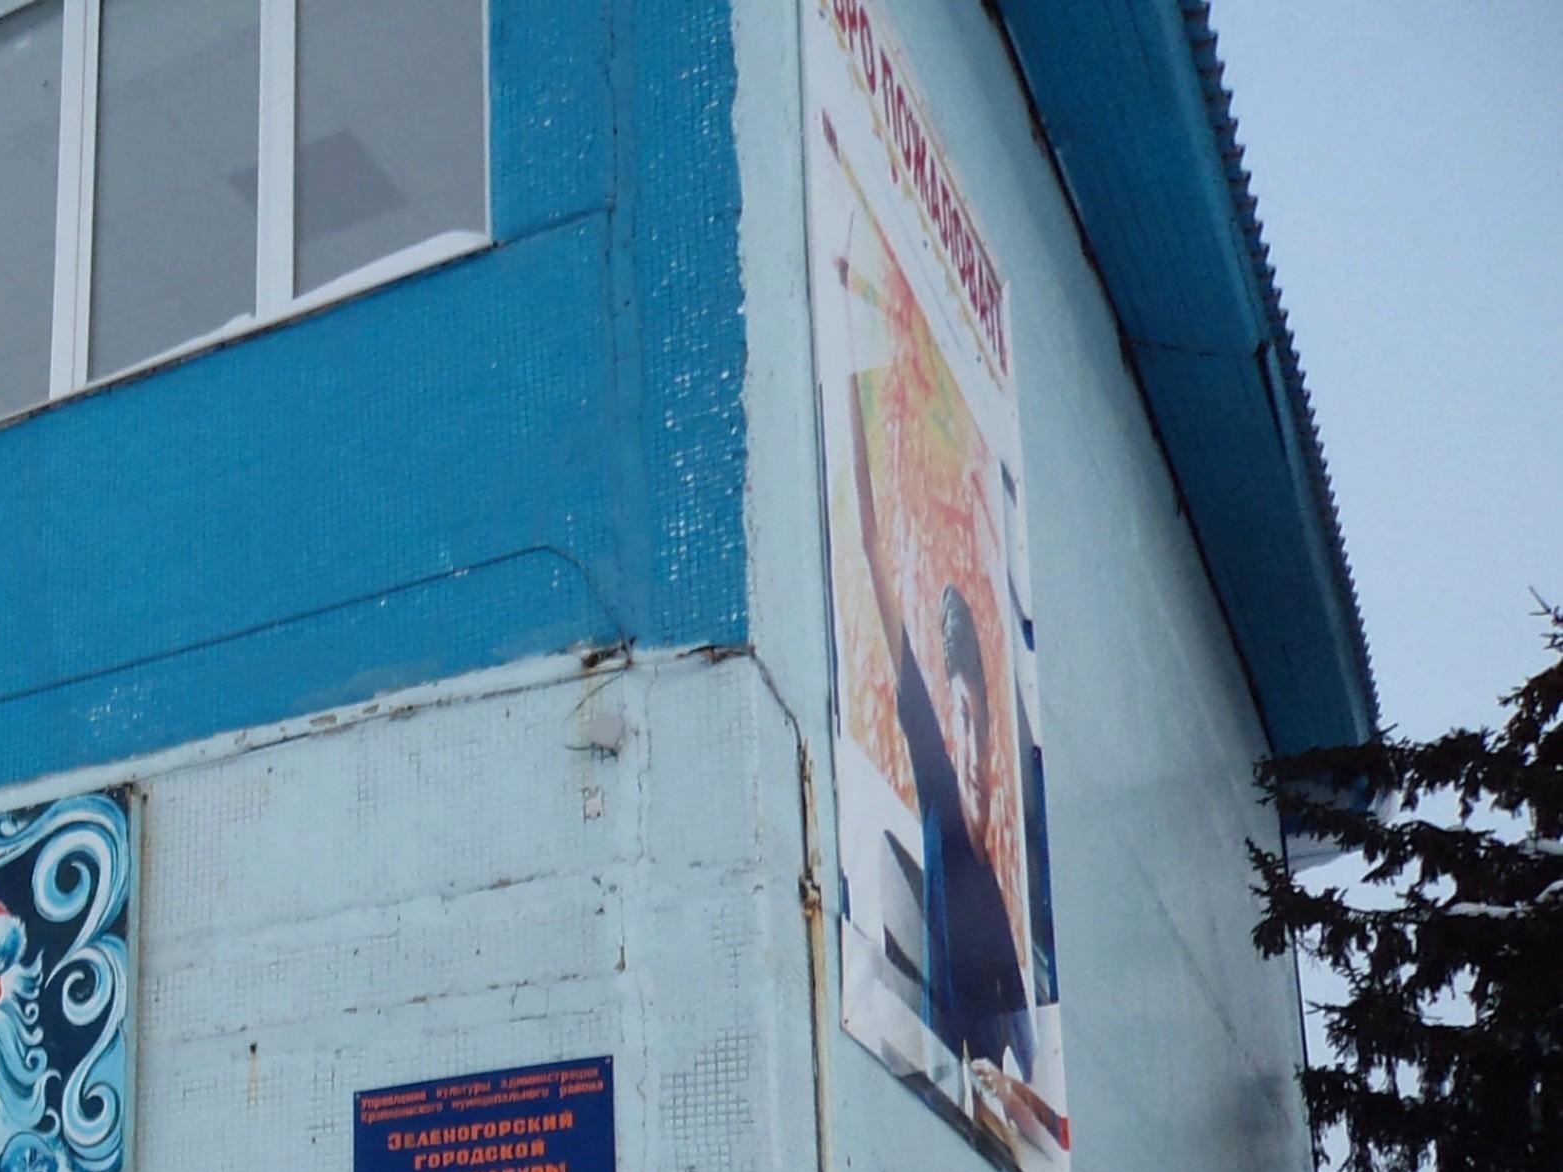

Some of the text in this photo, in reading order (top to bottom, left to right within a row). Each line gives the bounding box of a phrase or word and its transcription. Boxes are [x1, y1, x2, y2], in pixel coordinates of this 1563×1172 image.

[879, 48, 1008, 377] ПОЖАЛОВАТЬ
[436, 1080, 491, 1100] культуры
[413, 1138, 546, 1171] ГОРОДСКОЙ
